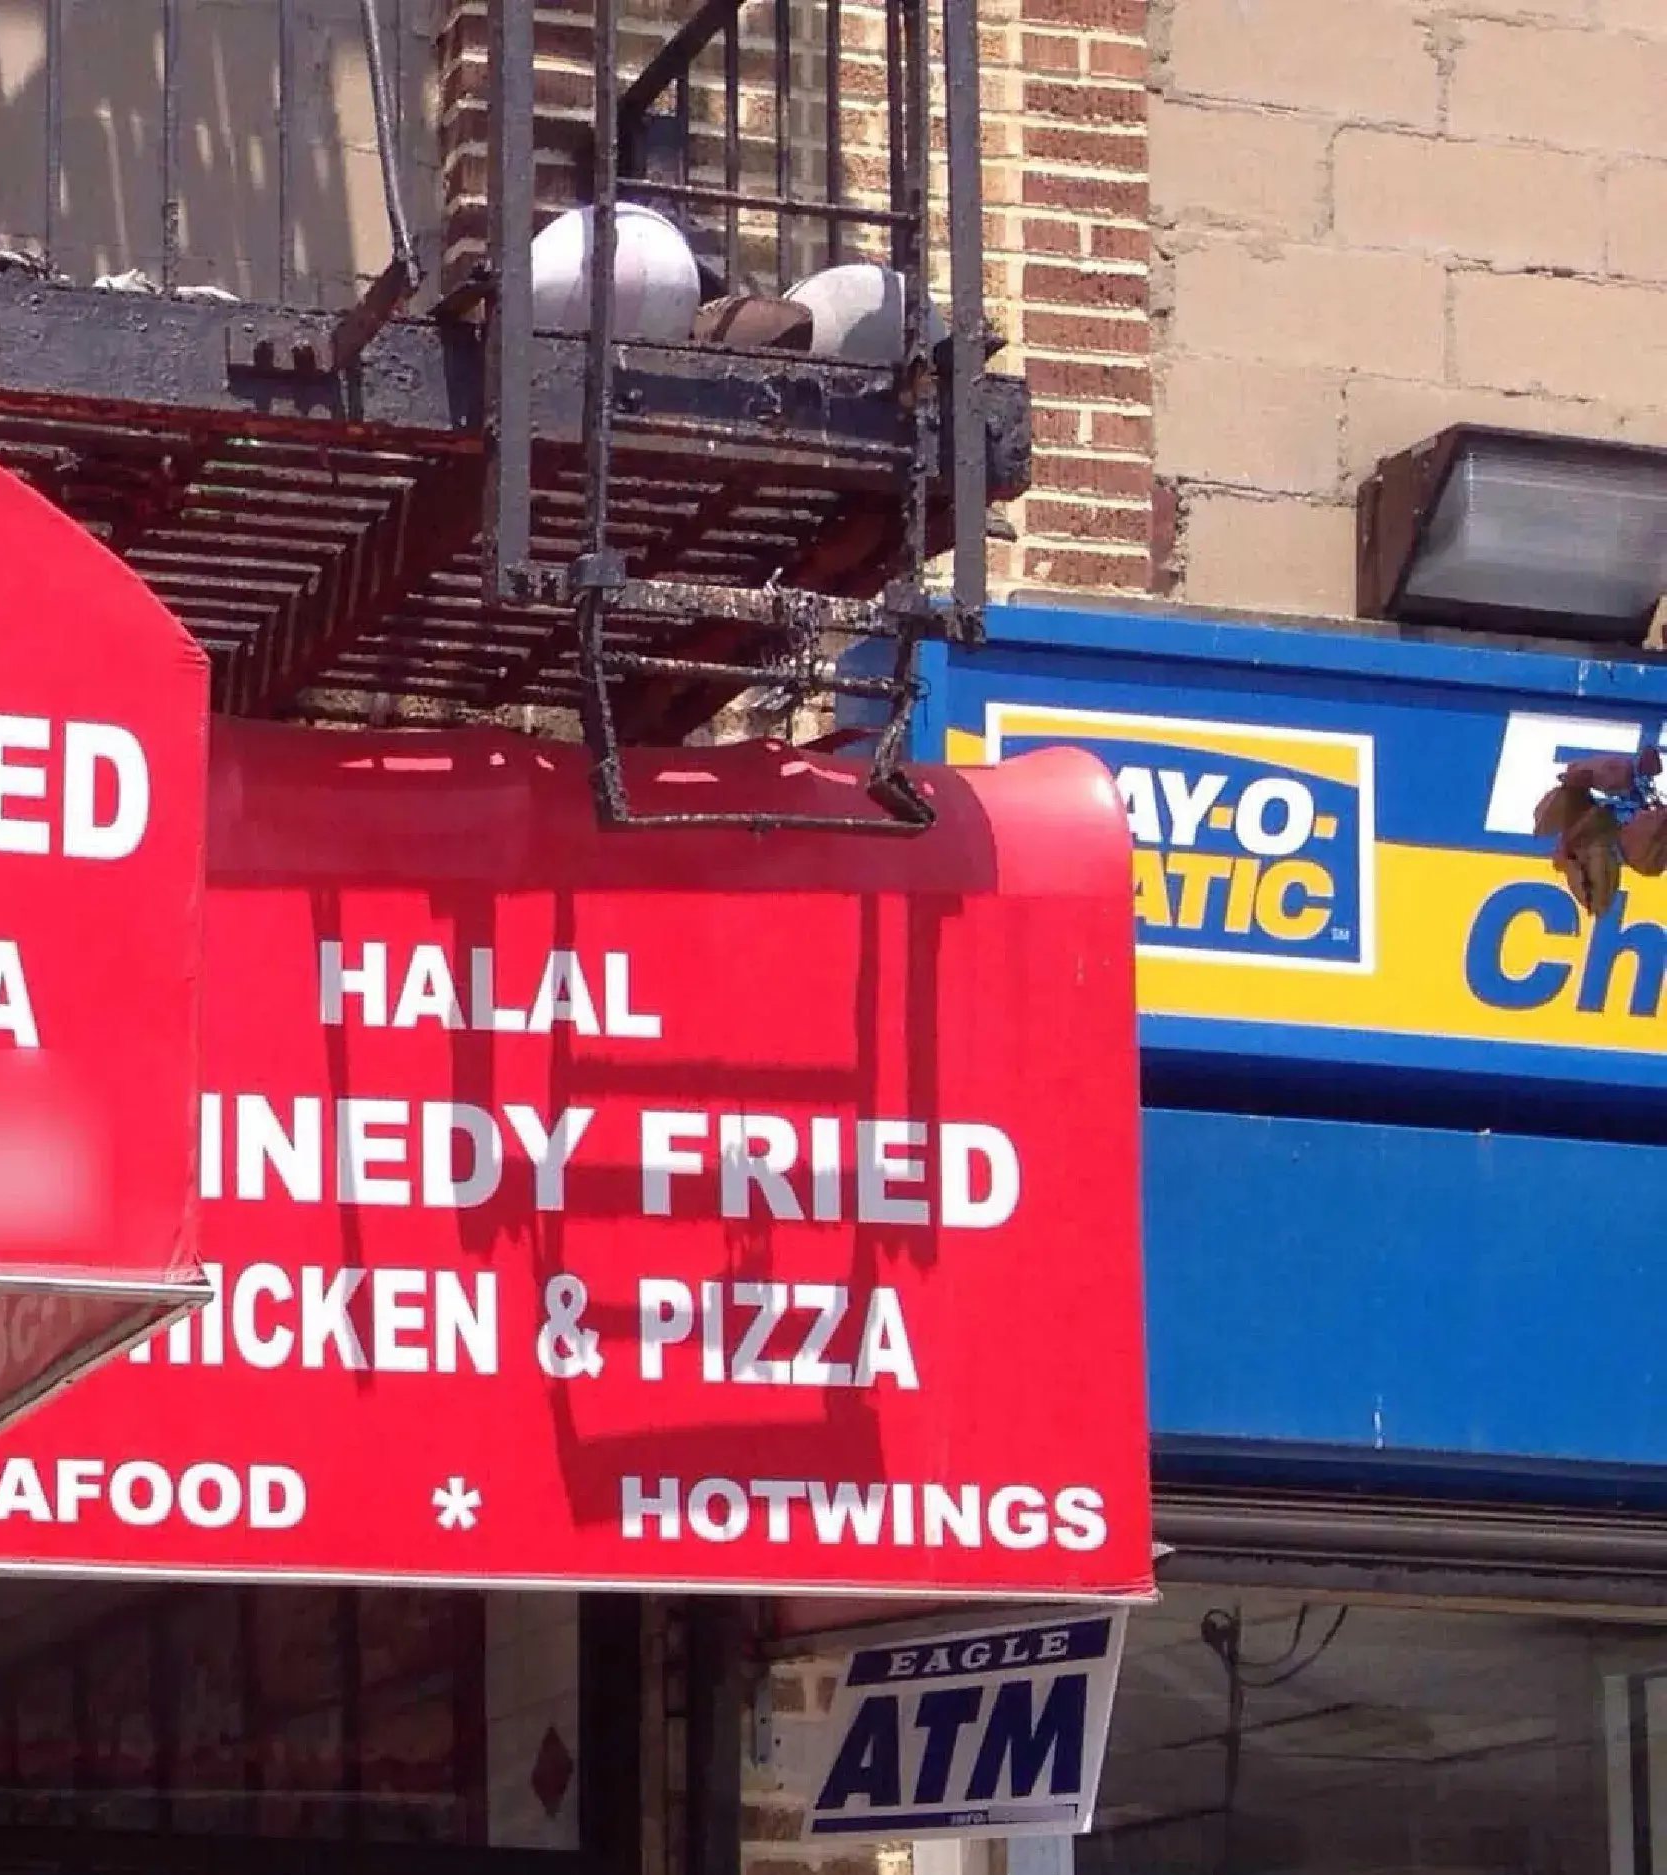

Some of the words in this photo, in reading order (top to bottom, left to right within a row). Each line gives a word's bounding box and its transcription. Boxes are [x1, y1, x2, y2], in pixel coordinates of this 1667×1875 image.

[320, 942, 661, 1038] HALAL
[641, 1110, 1019, 1228] FRIED
[536, 1274, 603, 1378] &
[639, 1279, 919, 1389] PIZZA
[622, 1477, 1106, 1550] HOTWINGS
[887, 1631, 1069, 1676] EAGLE
[813, 1673, 1087, 1810] ATM
